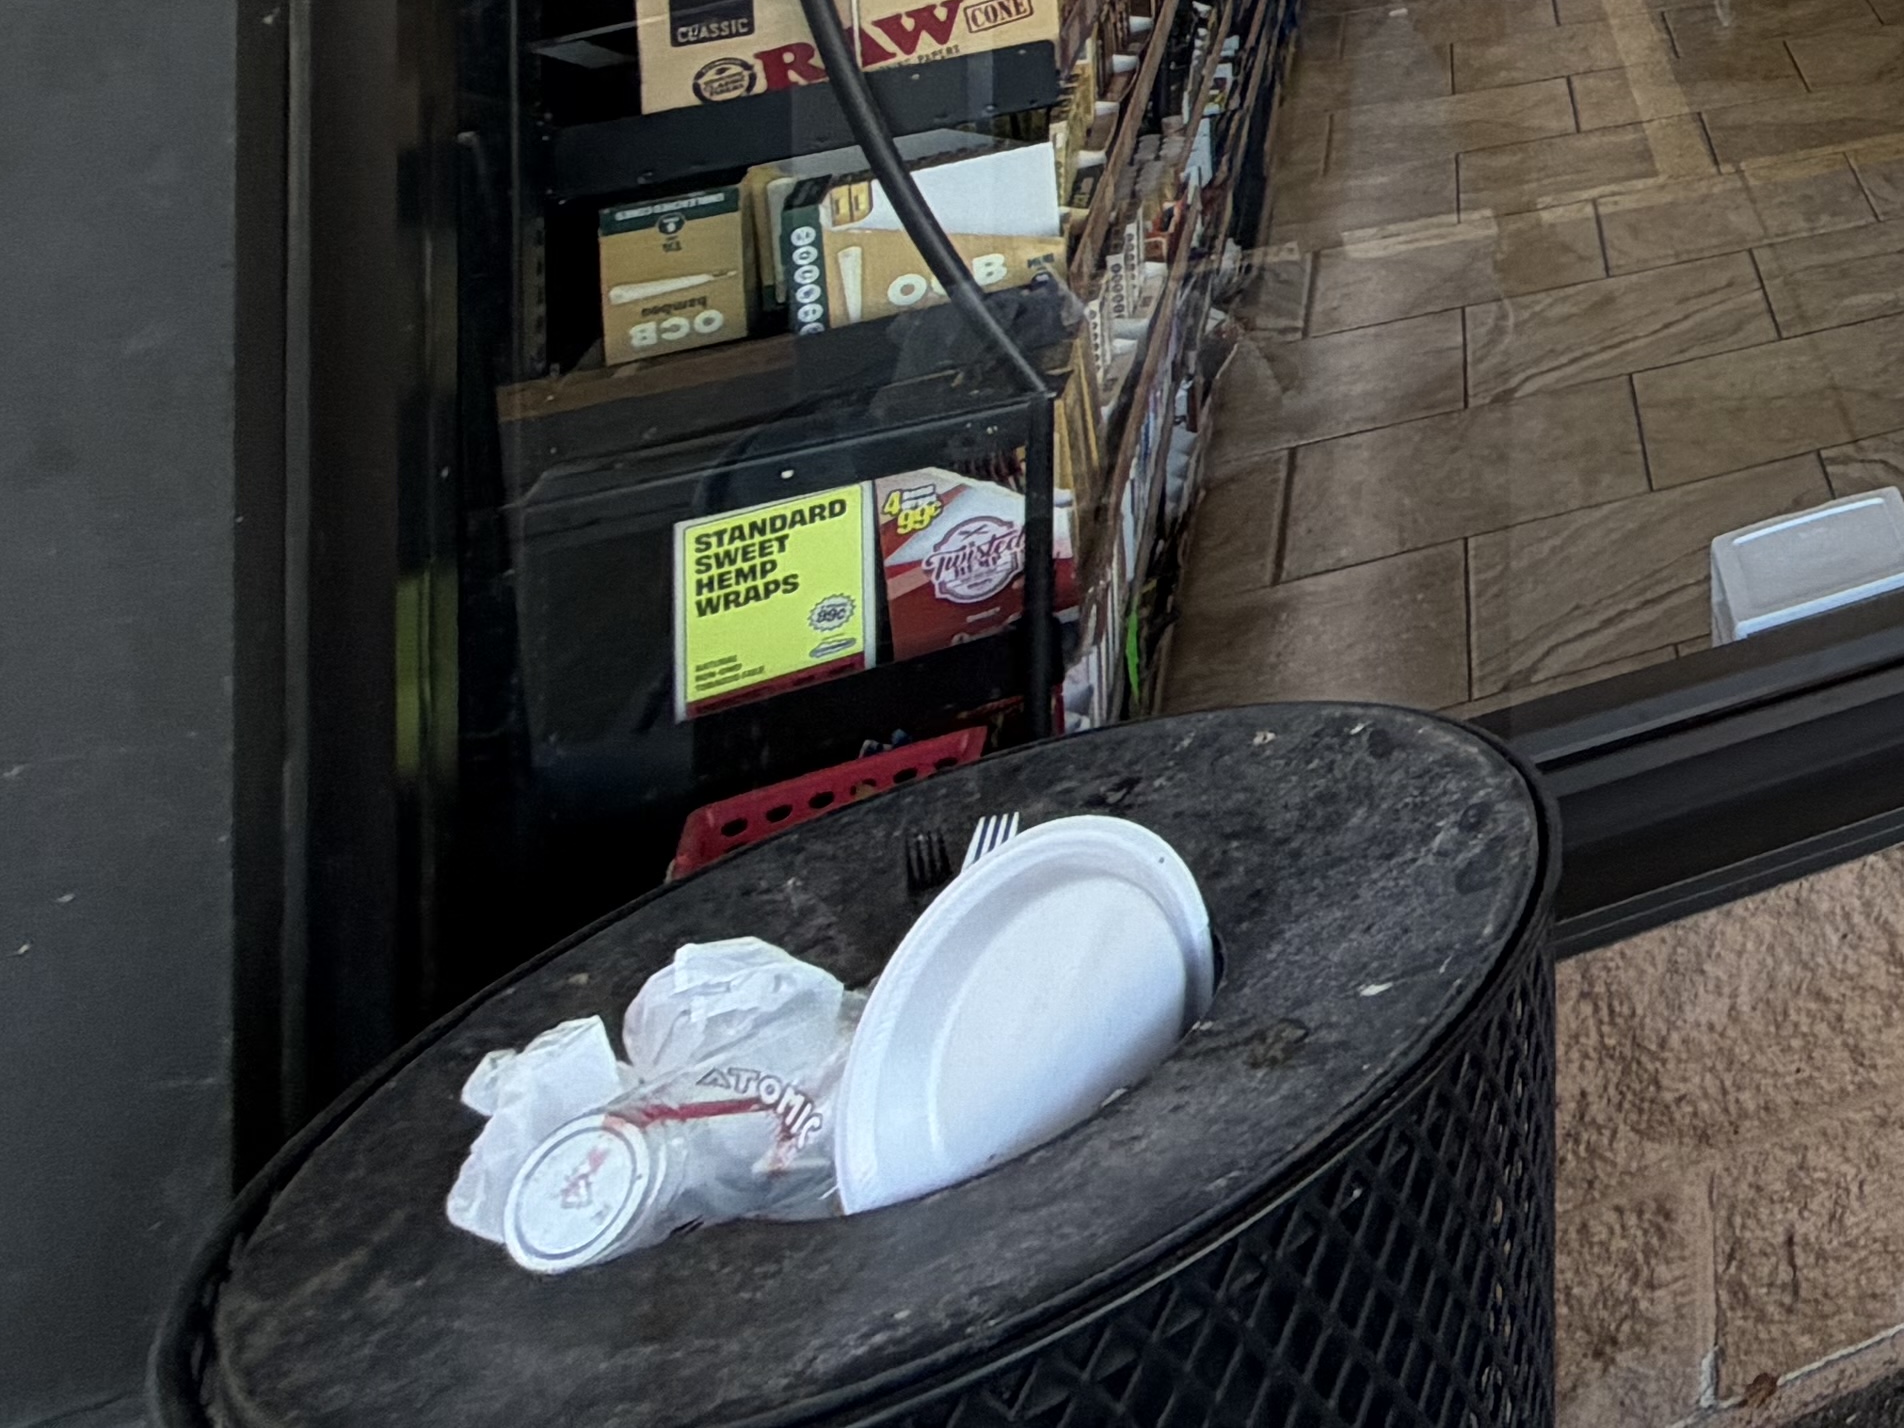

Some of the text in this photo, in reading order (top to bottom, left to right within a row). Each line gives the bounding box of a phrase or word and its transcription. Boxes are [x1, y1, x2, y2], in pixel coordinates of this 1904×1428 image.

[676, 16, 750, 44] CLASSIC
[887, 252, 1007, 307] OB
[630, 309, 724, 348] OCB
[883, 491, 901, 517] 4
[694, 498, 847, 554] STANDARD
[694, 534, 789, 575] SWEET
[922, 528, 1026, 580] Twisted
[695, 560, 777, 597] HEMP
[695, 574, 800, 618] WRAPS
[696, 1066, 823, 1150] ATOMIC
